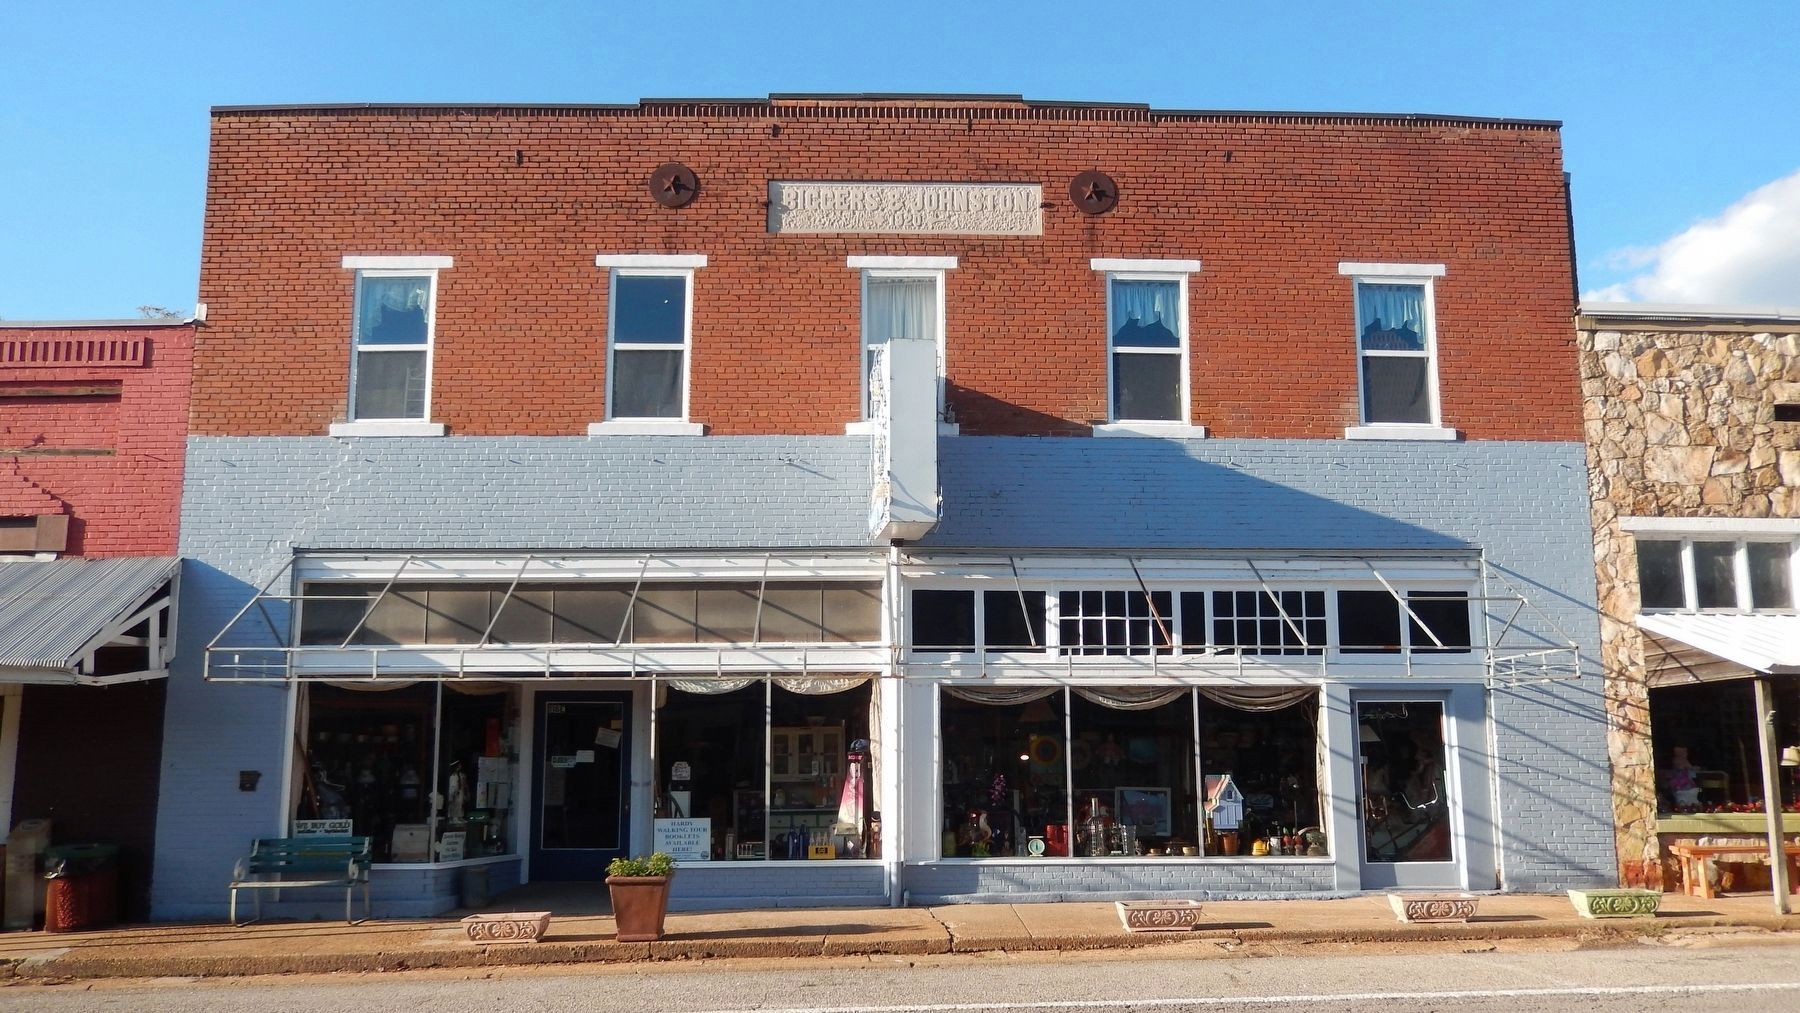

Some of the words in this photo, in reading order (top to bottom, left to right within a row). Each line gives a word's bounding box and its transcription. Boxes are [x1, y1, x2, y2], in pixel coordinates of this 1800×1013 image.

[783, 187, 882, 212] BIGGERS
[888, 188, 904, 212] &
[912, 188, 1031, 213] JOHNSTON
[296, 821, 308, 829] WE
[328, 821, 351, 829] GOLD
